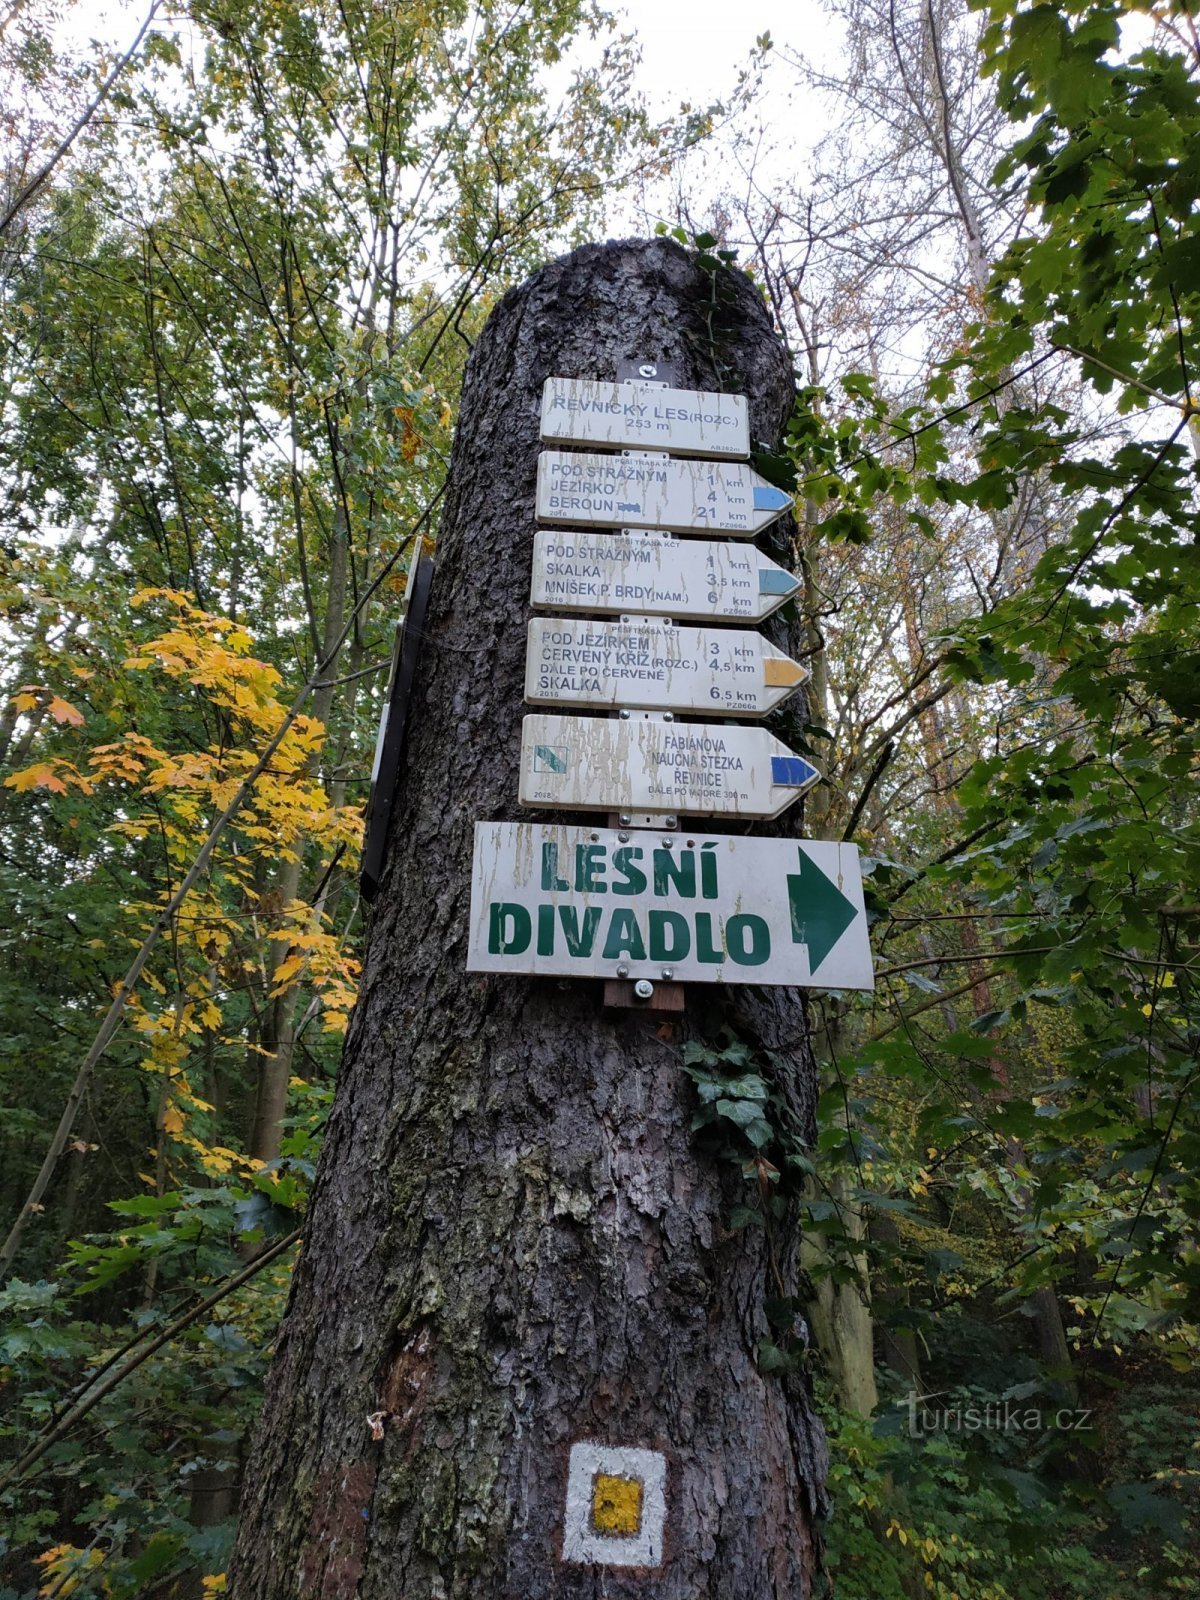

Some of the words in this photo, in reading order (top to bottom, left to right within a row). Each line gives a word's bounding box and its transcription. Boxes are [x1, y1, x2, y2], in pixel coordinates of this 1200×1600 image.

[553, 393, 648, 418] ŘEVNICKÝ
[626, 418, 652, 429] 253
[656, 423, 670, 431] m
[551, 464, 582, 477] POD
[587, 465, 667, 482] STRÁŽNÝM
[707, 475, 714, 486] 1
[726, 479, 744, 488] km
[549, 496, 613, 511] BEROUN
[697, 506, 716, 519] 21
[728, 512, 747, 521] km
[707, 491, 717, 502] 4
[727, 496, 745, 504] km
[546, 545, 574, 558] POD
[579, 547, 651, 563] STRÁŽNÝM
[707, 555, 714, 567] 1
[730, 561, 750, 570] km
[546, 563, 601, 577] SKALKA
[707, 573, 727, 587] 3,5
[731, 578, 750, 588] km
[545, 579, 596, 596] MNÍŠEK
[601, 585, 611, 597] P.
[707, 591, 718, 604] 6
[732, 597, 752, 606] km
[542, 632, 572, 646] POD
[577, 633, 649, 650] JEZÍRKEM
[710, 642, 720, 655] 3
[734, 647, 754, 657] km
[542, 645, 611, 665] ČERVENÝ
[616, 650, 649, 667] KŘÍŽ
[708, 658, 731, 672] 4,5
[735, 663, 755, 673] km
[580, 666, 598, 677] PO
[602, 667, 665, 681] ČERVENÉ
[540, 676, 601, 692] SKALKA
[736, 691, 757, 701] km
[664, 735, 726, 753] FABIÁNOVA
[652, 751, 699, 768] NAUČNÁ
[701, 755, 744, 770] STEZKA
[674, 768, 722, 787] ŘEVNICE
[675, 787, 687, 796] PO
[724, 791, 738, 799] 300
[541, 841, 719, 900] LESNÍ
[488, 902, 771, 966] DIVADLO
